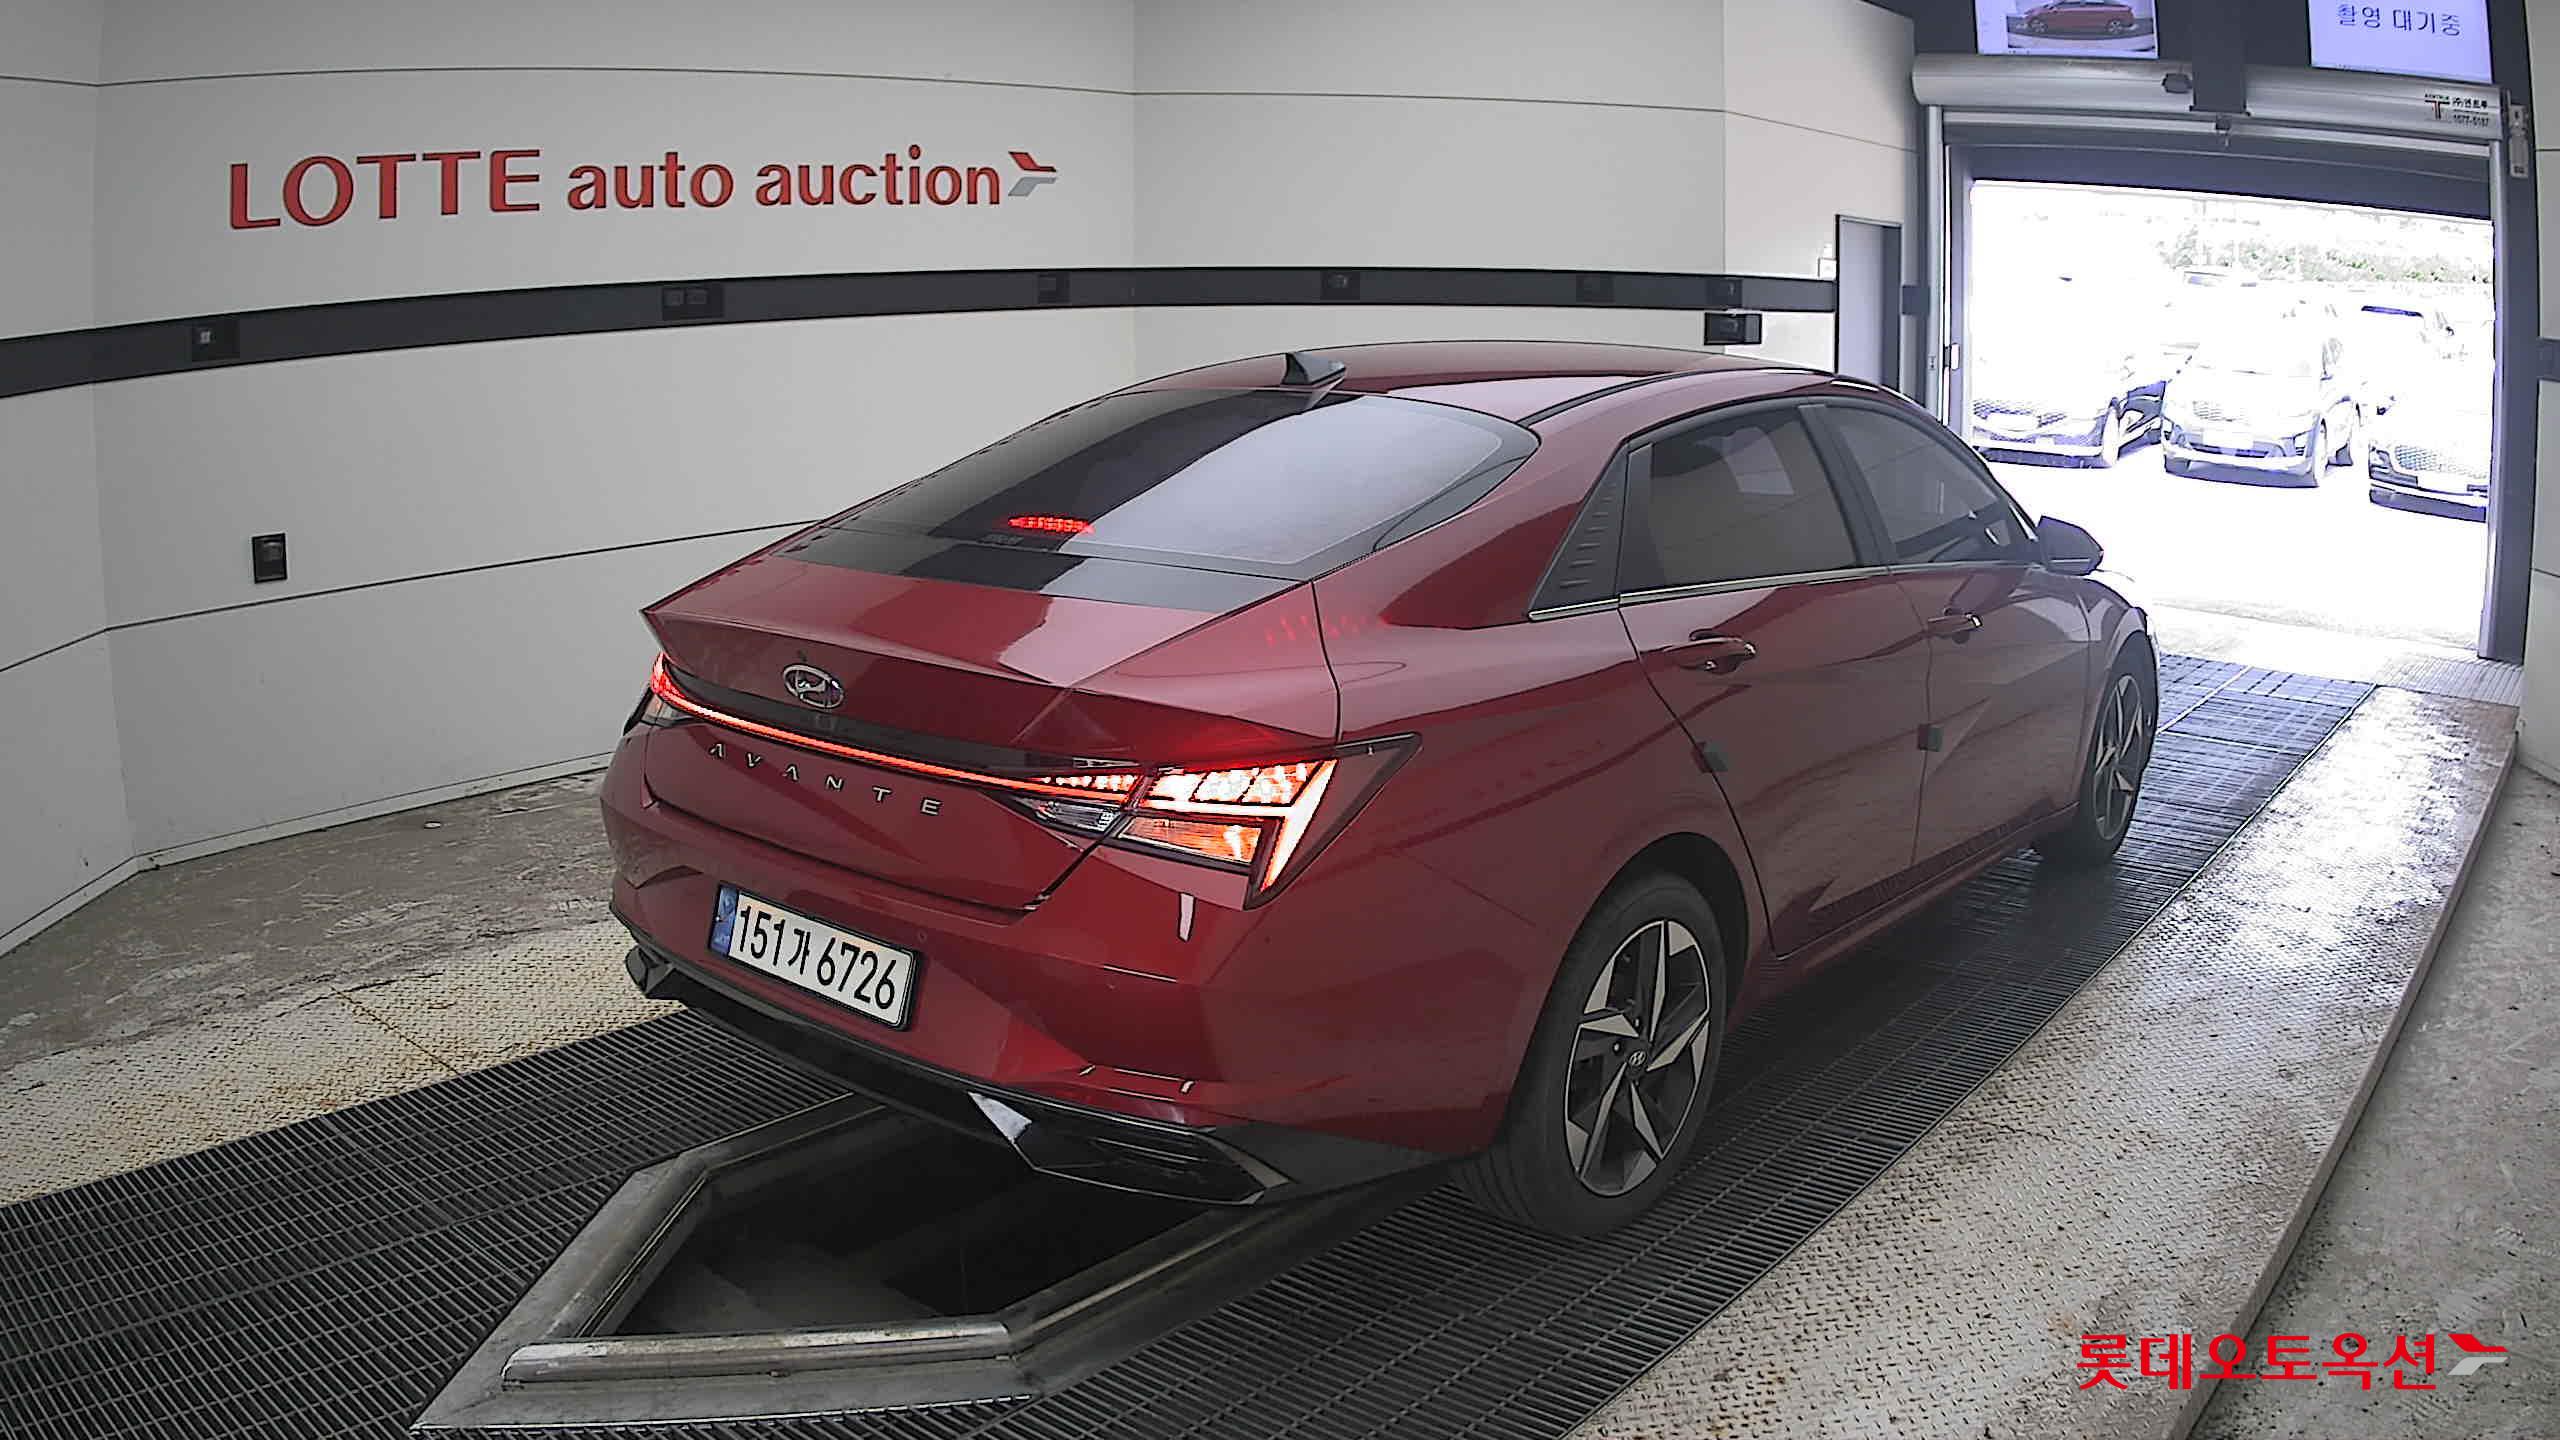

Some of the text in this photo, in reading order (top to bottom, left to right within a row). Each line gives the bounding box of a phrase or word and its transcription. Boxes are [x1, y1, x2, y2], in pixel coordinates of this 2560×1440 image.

[2392, 9, 2460, 36] 대기중
[229, 144, 1002, 231] LOTTE auto auction
[709, 743, 942, 815] AVANTE
